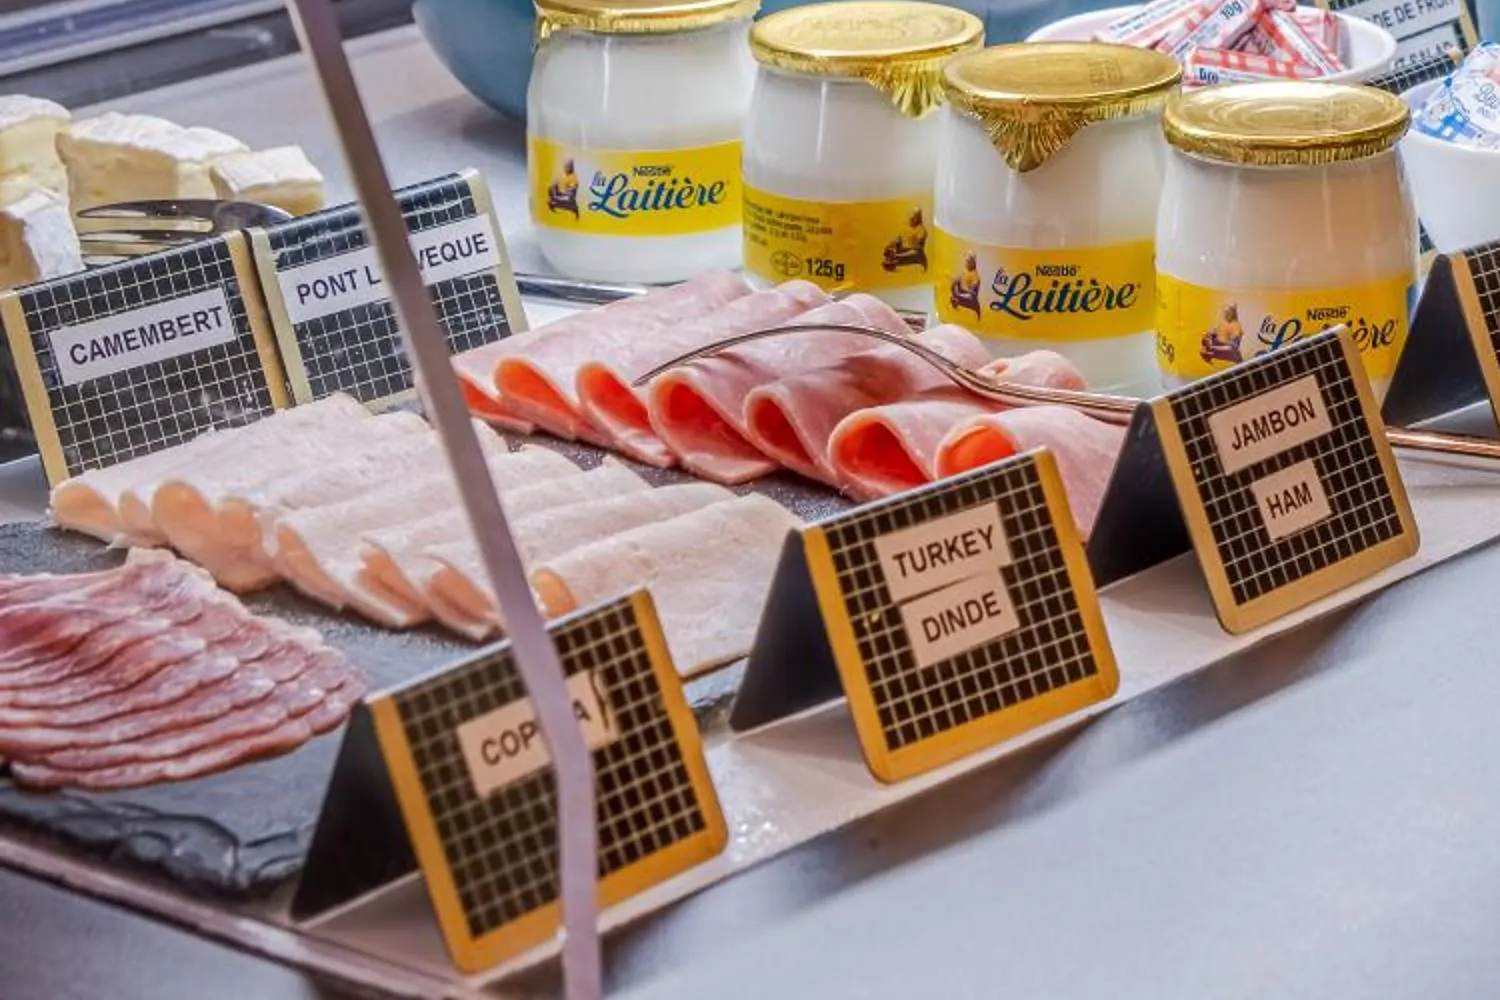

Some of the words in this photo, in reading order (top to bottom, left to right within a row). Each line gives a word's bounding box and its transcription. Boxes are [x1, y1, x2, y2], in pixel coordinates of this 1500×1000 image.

[1393, 2, 1417, 24] DE
[587, 173, 726, 219] Laitière
[296, 268, 359, 305] PONT
[988, 272, 1137, 321] Laitière
[69, 305, 225, 366] CAMEMBERT
[1231, 396, 1316, 451] JAMBON
[1265, 480, 1314, 520] HAM
[892, 524, 996, 579] TURKEY
[920, 591, 1003, 643] DINDE
[480, 699, 591, 767] COPA
